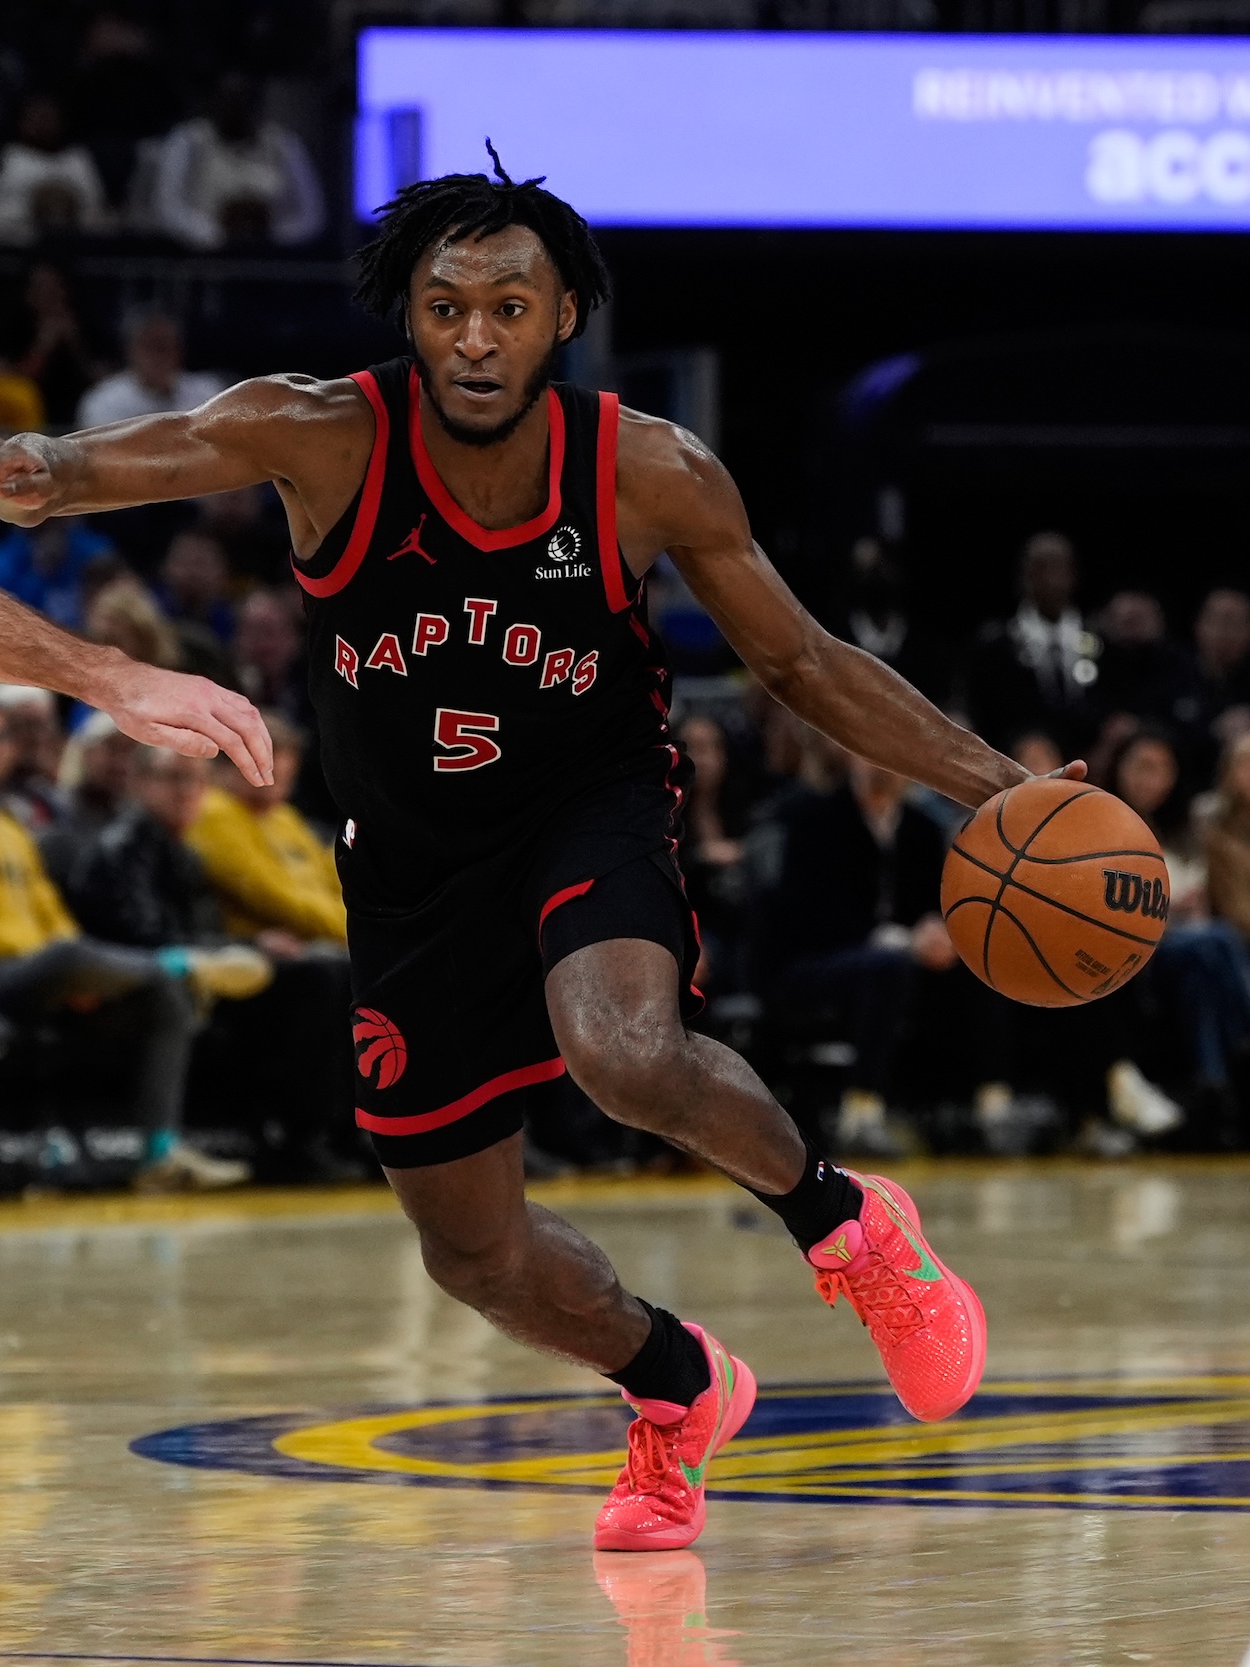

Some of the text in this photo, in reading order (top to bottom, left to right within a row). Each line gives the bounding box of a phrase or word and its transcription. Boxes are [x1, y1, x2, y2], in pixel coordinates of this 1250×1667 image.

[534, 563, 592, 580] Sun Life
[334, 597, 599, 696] RAPTORS
[433, 707, 501, 772] 5
[1102, 868, 1170, 922] Wils
